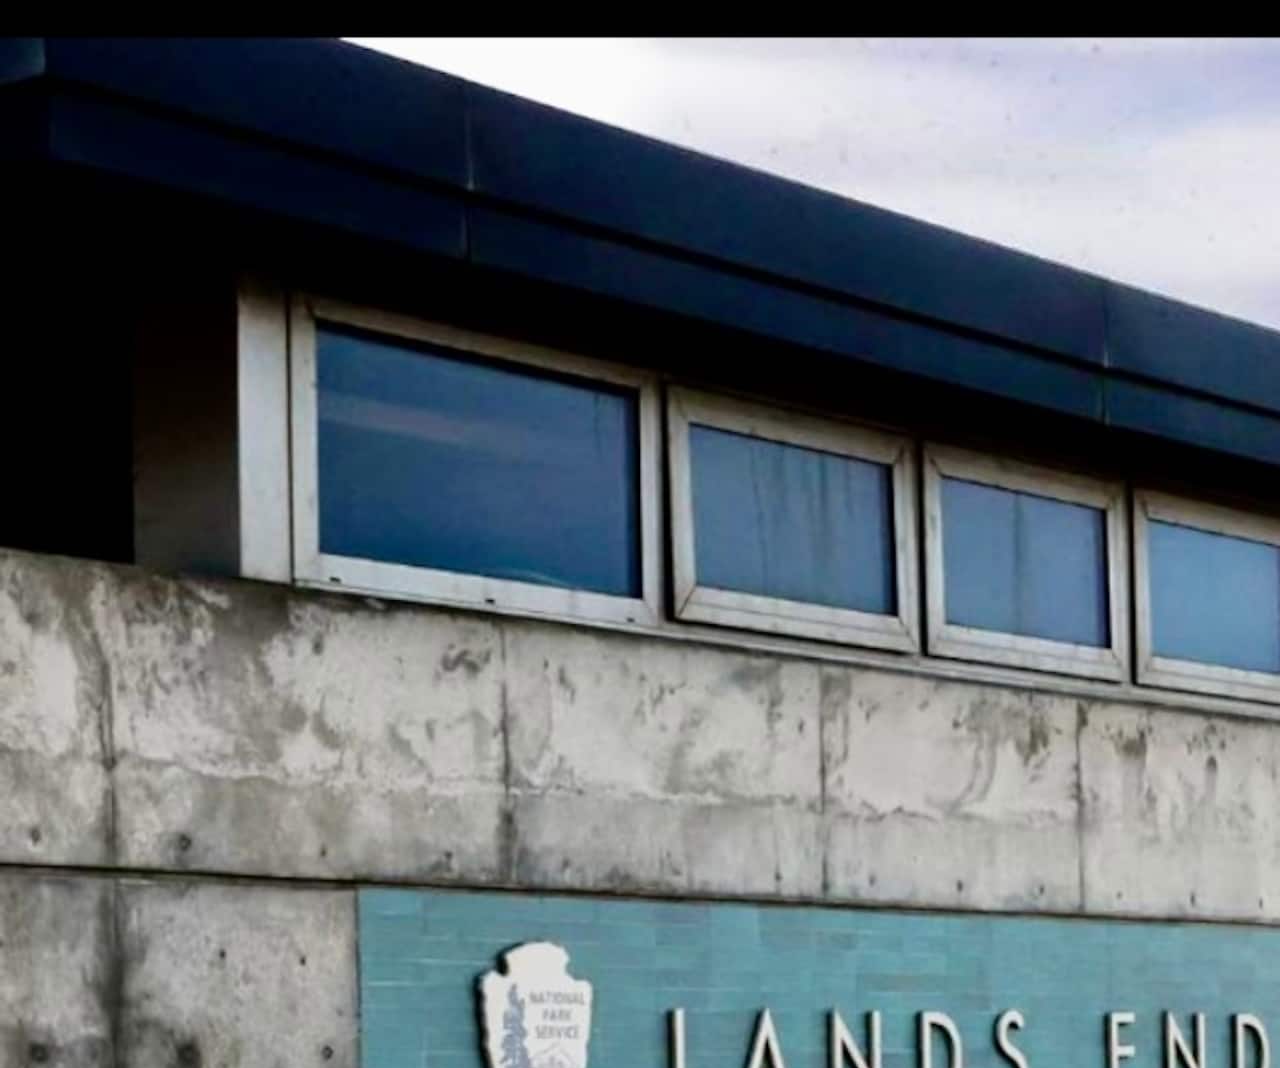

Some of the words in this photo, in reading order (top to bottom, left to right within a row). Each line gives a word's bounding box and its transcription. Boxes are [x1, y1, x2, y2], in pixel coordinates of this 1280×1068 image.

[528, 991, 585, 1006] NATIONAL
[542, 1007, 573, 1022] PARK
[535, 1024, 579, 1040] SERVICE
